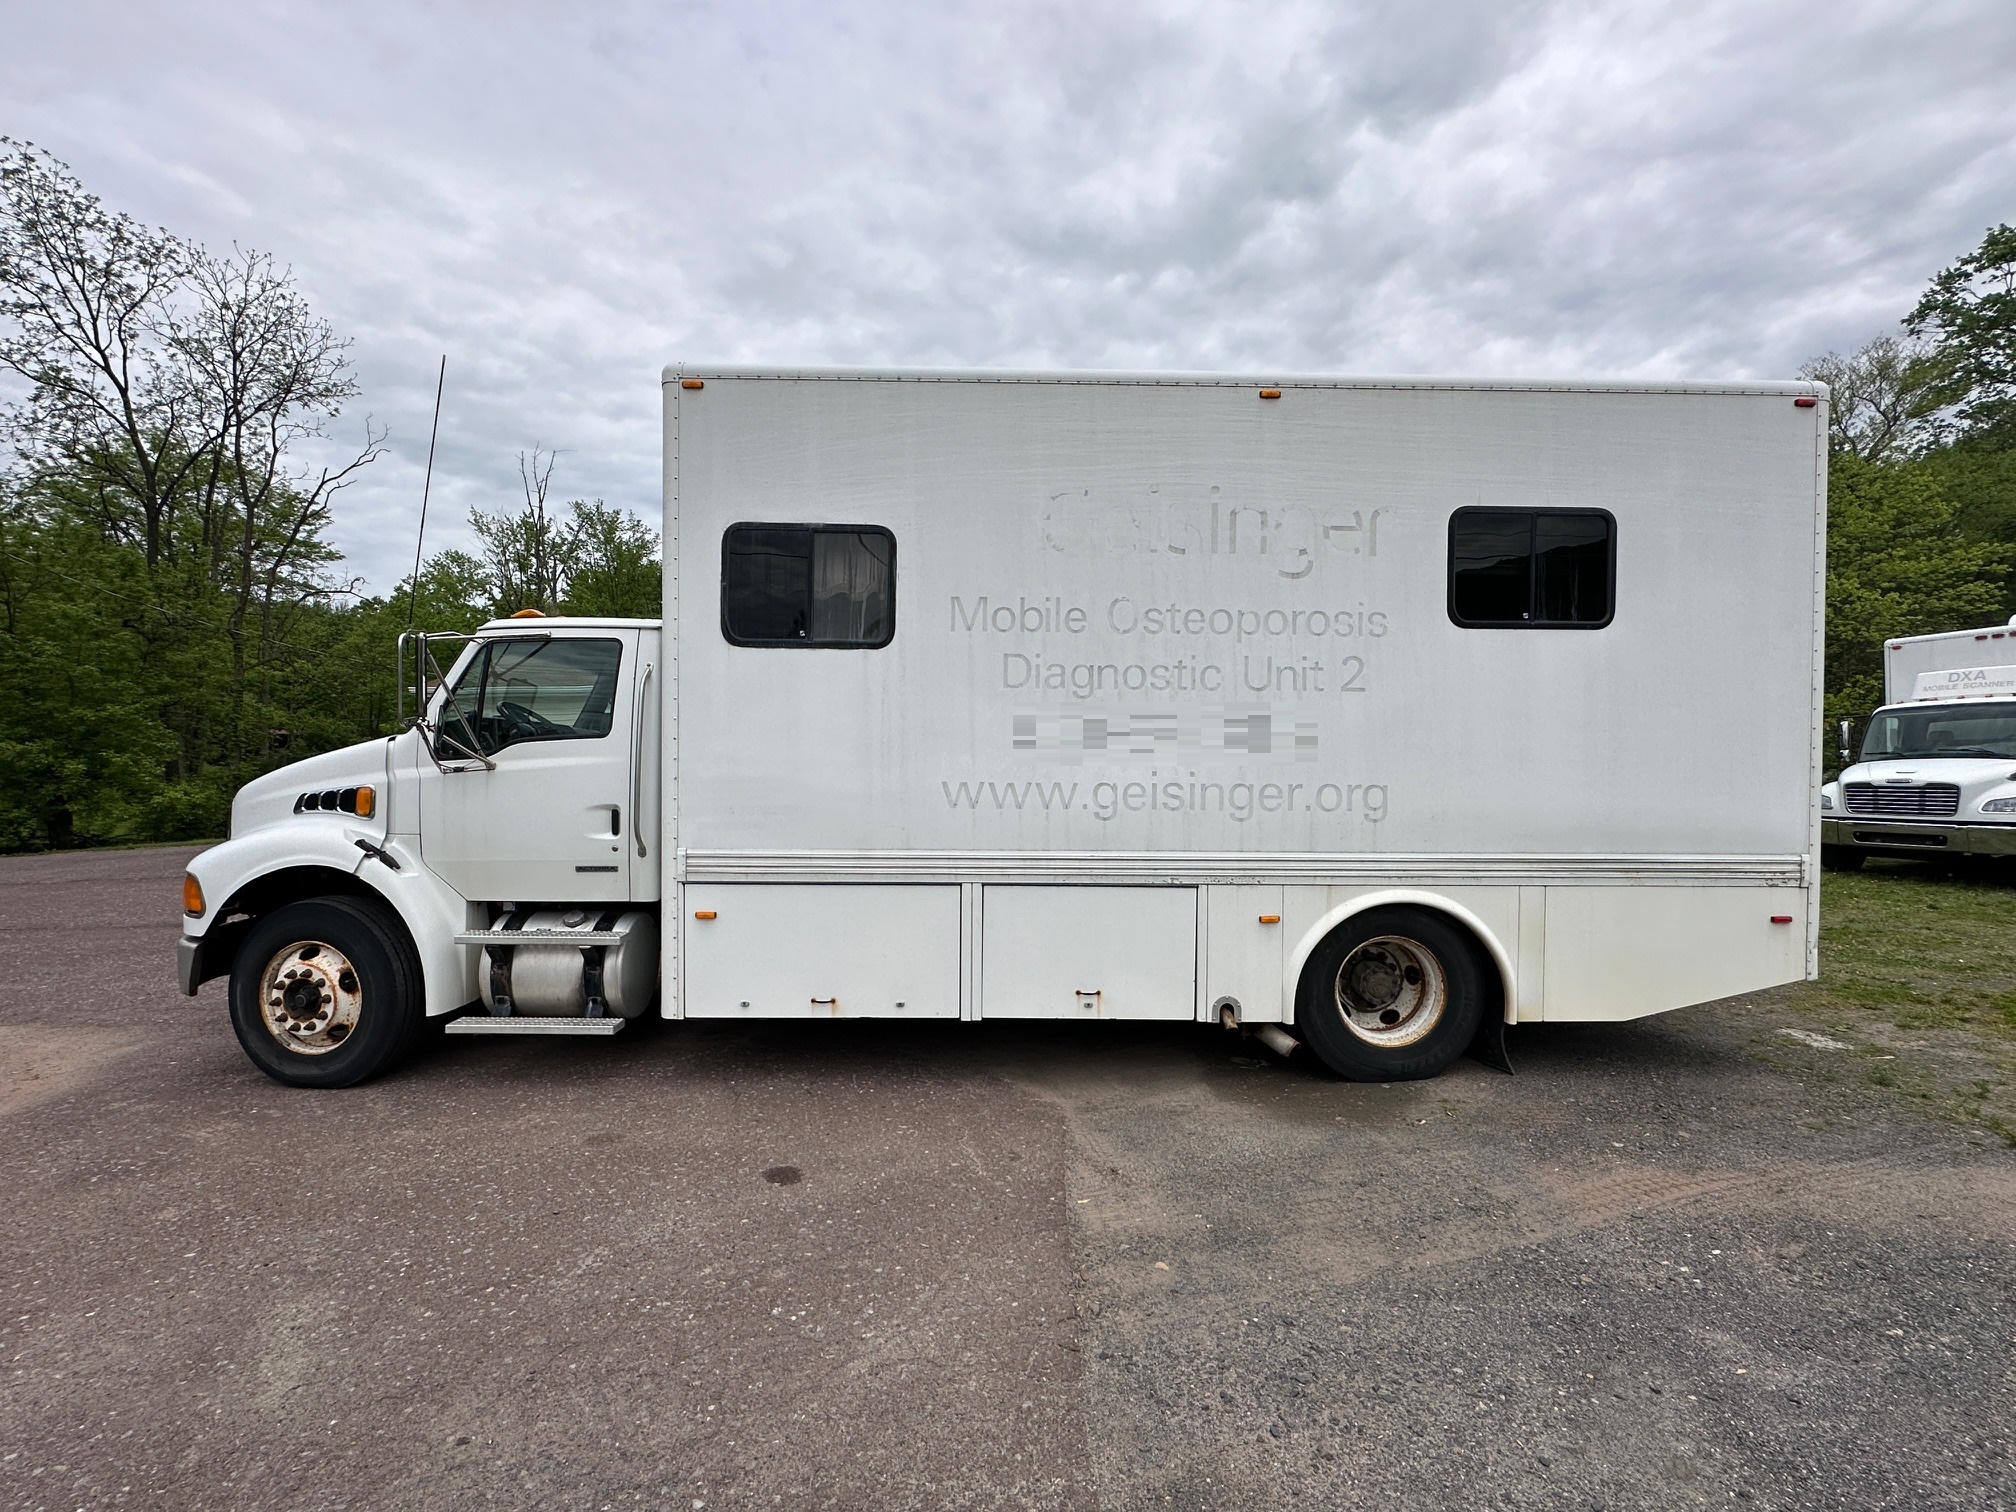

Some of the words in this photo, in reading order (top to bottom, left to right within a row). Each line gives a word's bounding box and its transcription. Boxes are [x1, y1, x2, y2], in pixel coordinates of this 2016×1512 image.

[949, 596, 1088, 633] Mobile
[1107, 596, 1389, 643] Osteoporosis
[1002, 653, 1222, 699] Diagnostic
[1243, 655, 1325, 693] Unit
[1340, 655, 1367, 693] 2
[1922, 683, 1959, 692] MOBILE
[1962, 681, 2014, 689] SCANNER
[1948, 670, 1986, 682] DXA
[941, 770, 1389, 824] www.geisinger.org
